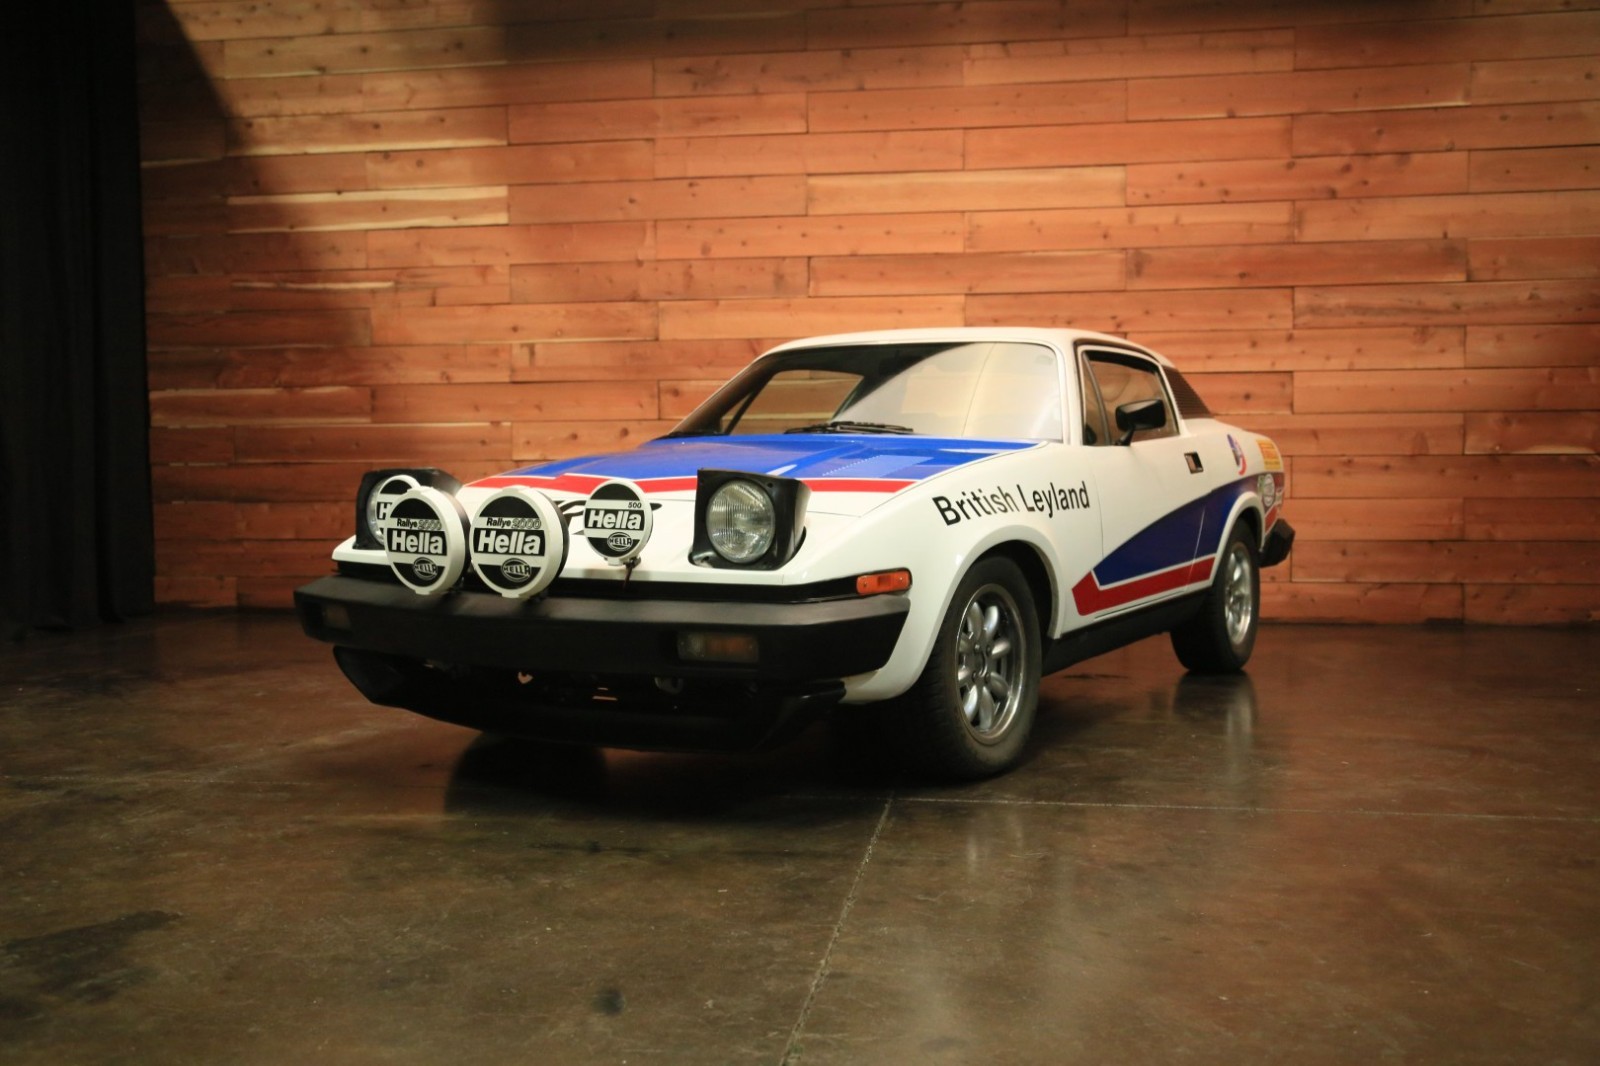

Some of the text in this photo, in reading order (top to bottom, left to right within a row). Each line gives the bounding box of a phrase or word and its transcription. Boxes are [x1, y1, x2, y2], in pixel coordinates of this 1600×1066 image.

[932, 480, 1090, 526] British Leyland
[397, 518, 418, 530] Rallye
[487, 517, 512, 528] Rallye
[587, 510, 642, 530] Hella
[391, 530, 443, 555] Hella
[477, 530, 541, 555] Hella
[609, 537, 633, 546] HELLA
[415, 563, 437, 574] HELLA
[503, 565, 531, 575] HELLA
